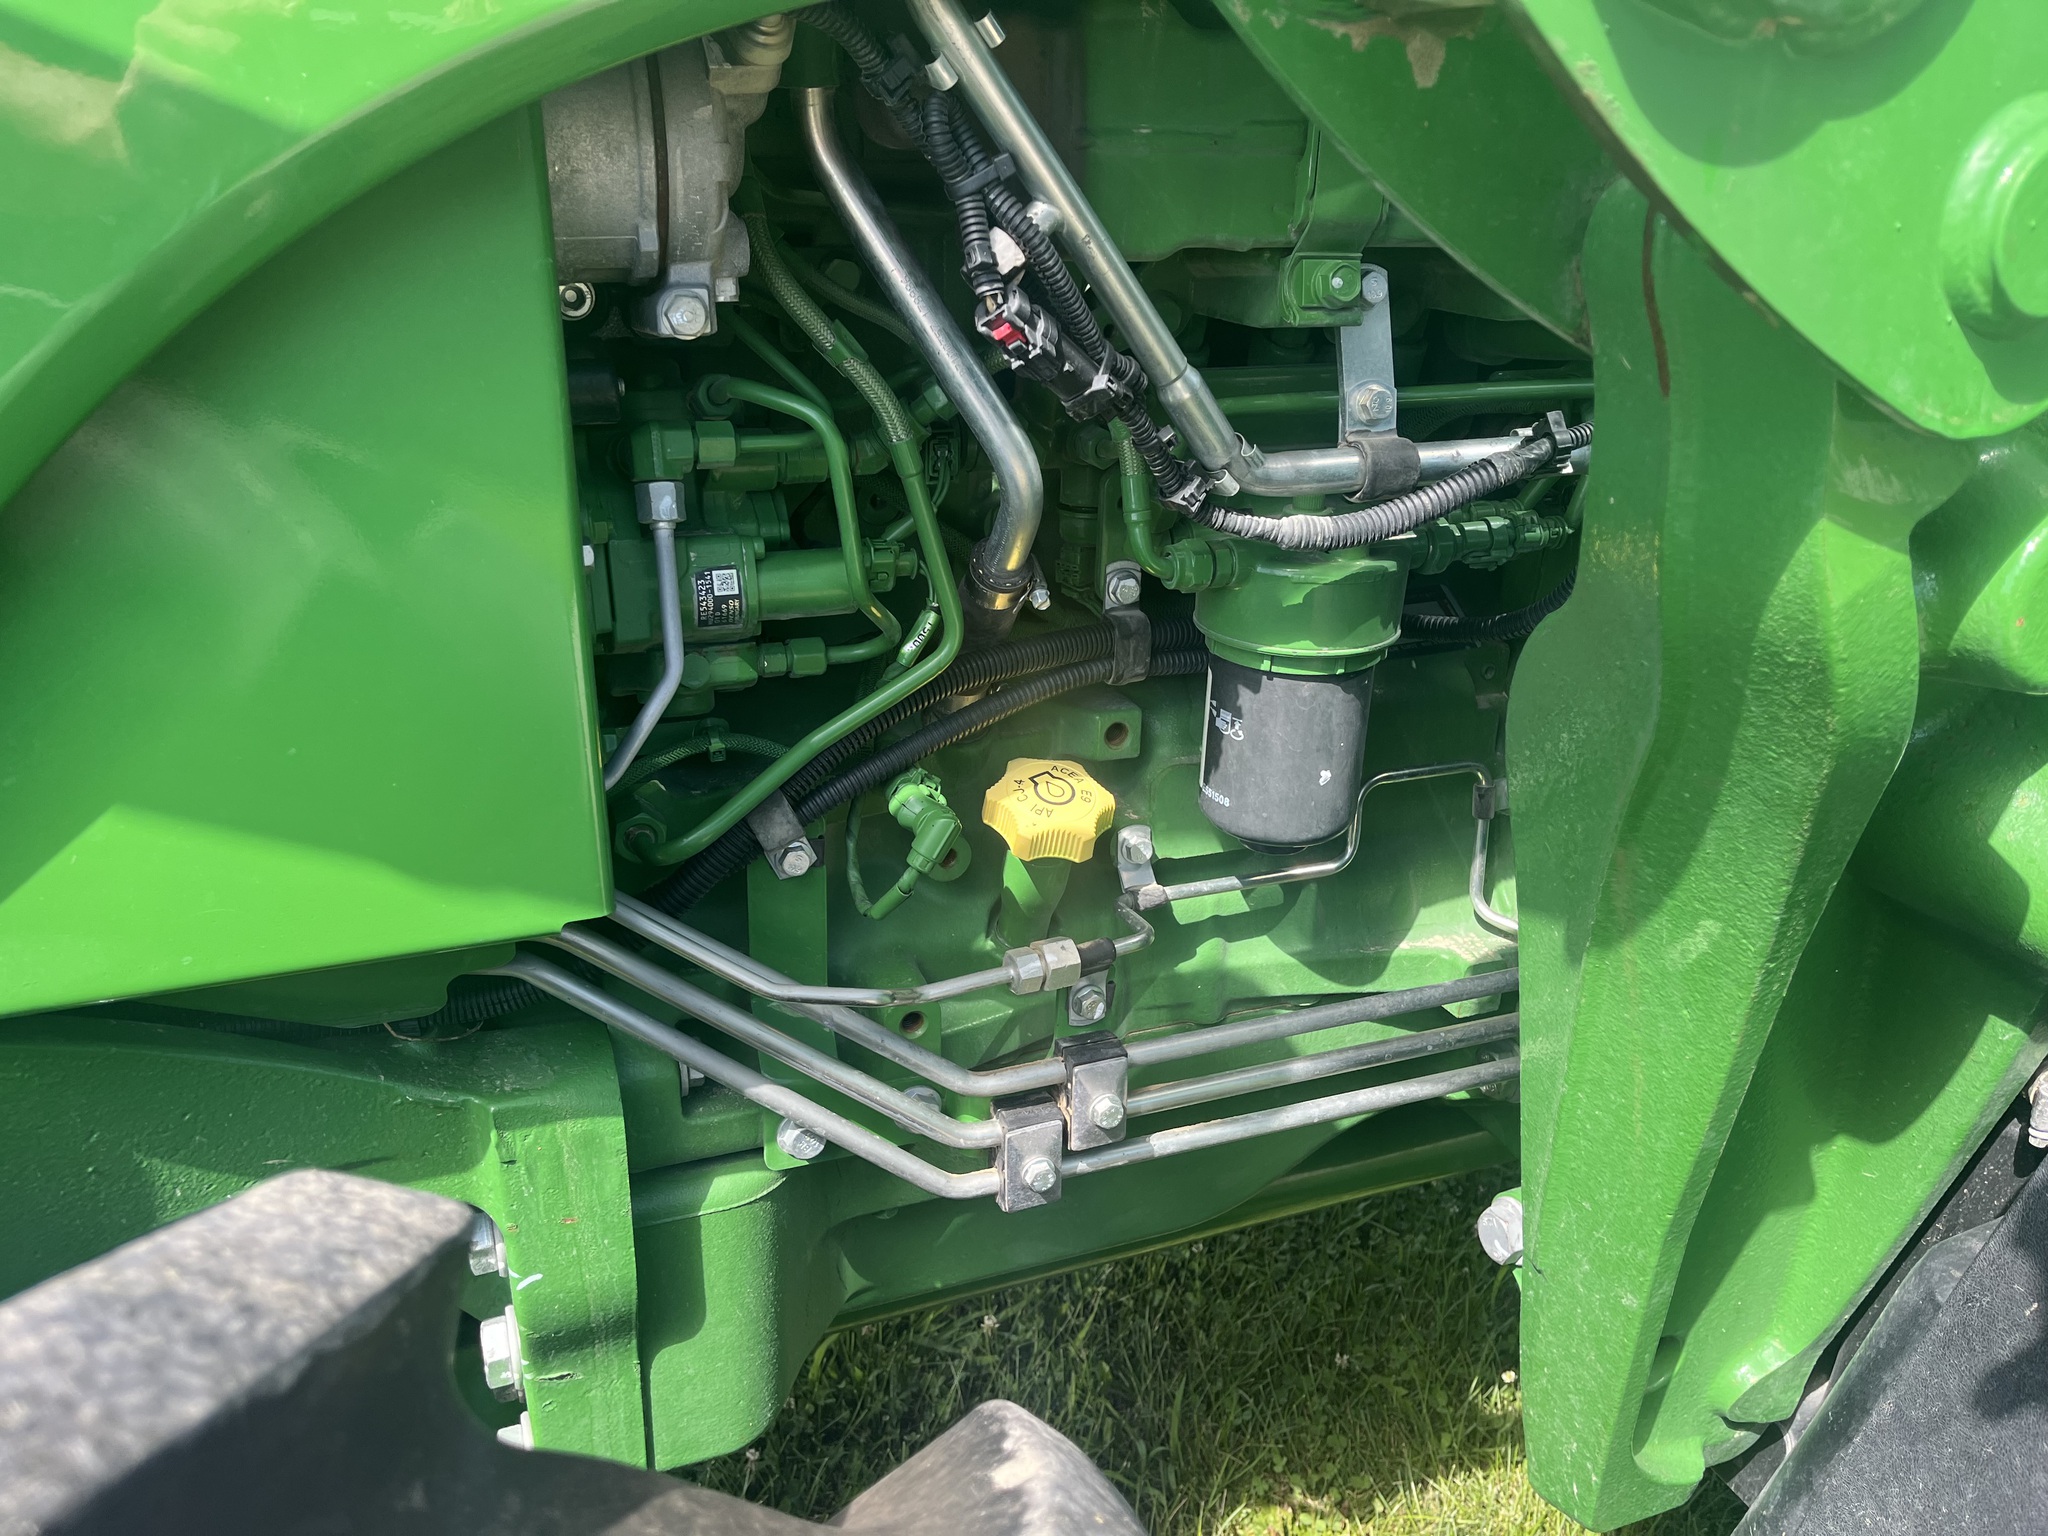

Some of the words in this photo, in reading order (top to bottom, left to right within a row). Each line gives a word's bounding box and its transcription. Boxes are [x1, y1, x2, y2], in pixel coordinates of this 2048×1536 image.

[697, 579, 708, 621] RE543423
[1013, 778, 1029, 803] CJ-4
[1050, 765, 1084, 784] ACEA
[1081, 789, 1093, 803] E9
[1030, 803, 1054, 818] API
